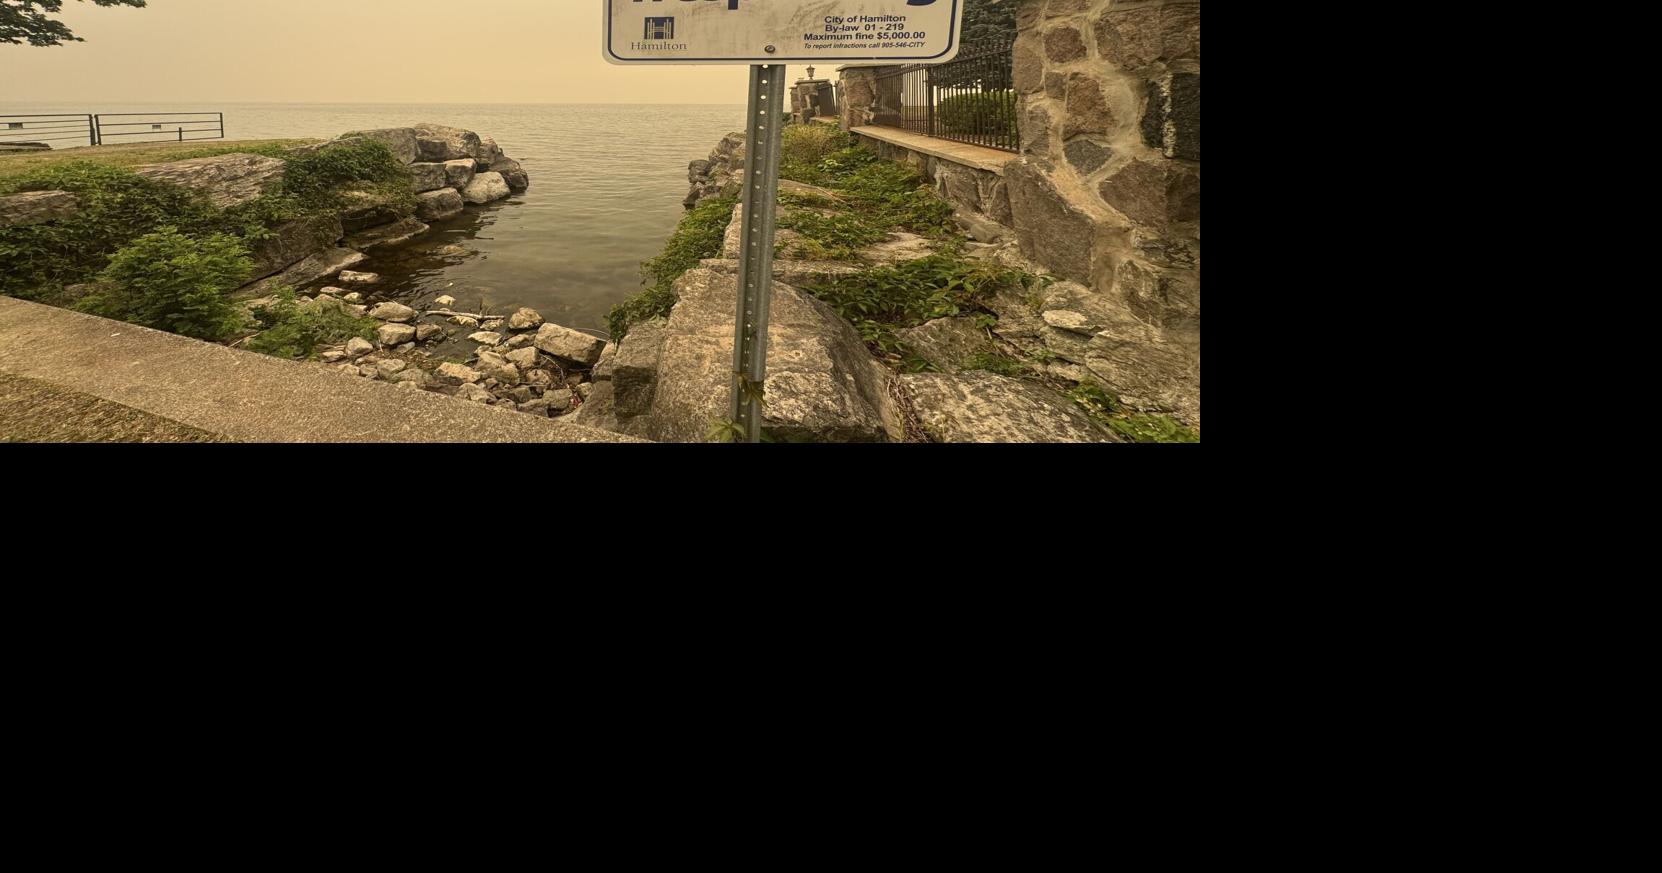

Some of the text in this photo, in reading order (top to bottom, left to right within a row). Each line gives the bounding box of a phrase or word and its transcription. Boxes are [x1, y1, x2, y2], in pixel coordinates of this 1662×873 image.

[824, 16, 844, 24] City
[825, 24, 858, 32] By-law
[877, 32, 925, 40] $5,000.00
[631, 42, 687, 50] Hamilton
